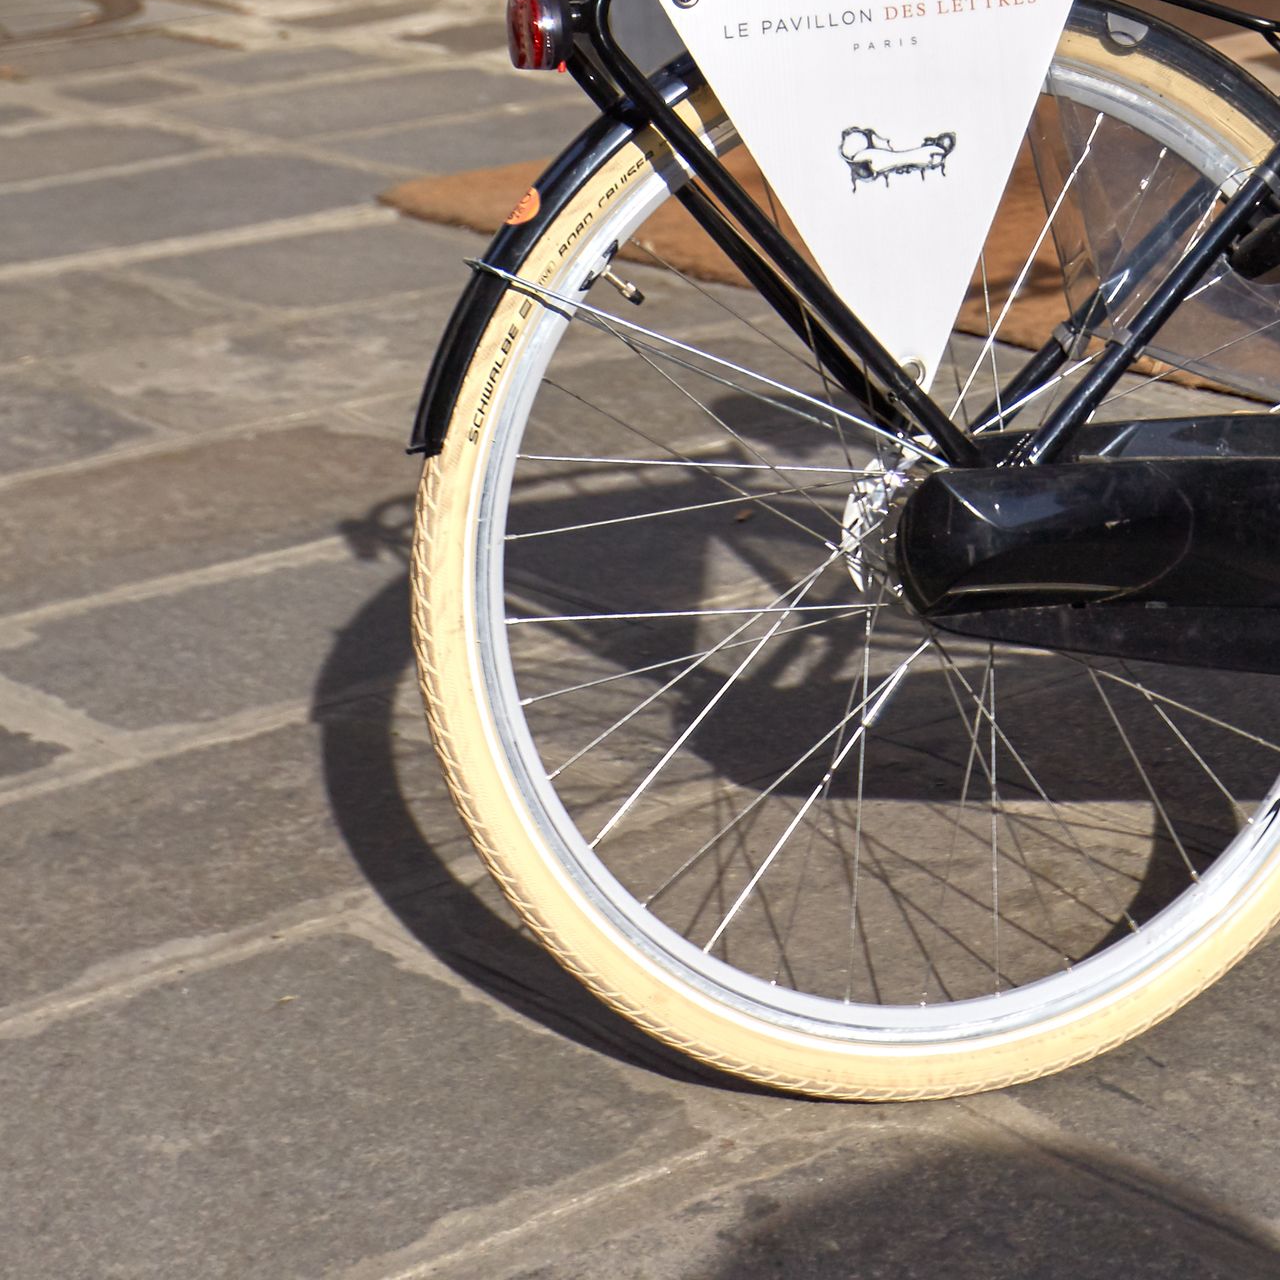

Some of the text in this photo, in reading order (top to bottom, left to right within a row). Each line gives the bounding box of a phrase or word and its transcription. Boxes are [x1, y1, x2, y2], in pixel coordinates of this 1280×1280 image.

[723, 22, 750, 40] LE
[761, 8, 873, 36] PAVILLON
[884, 2, 927, 21] DES
[853, 36, 919, 52] PARIS
[468, 323, 520, 445] SCHWALBE
